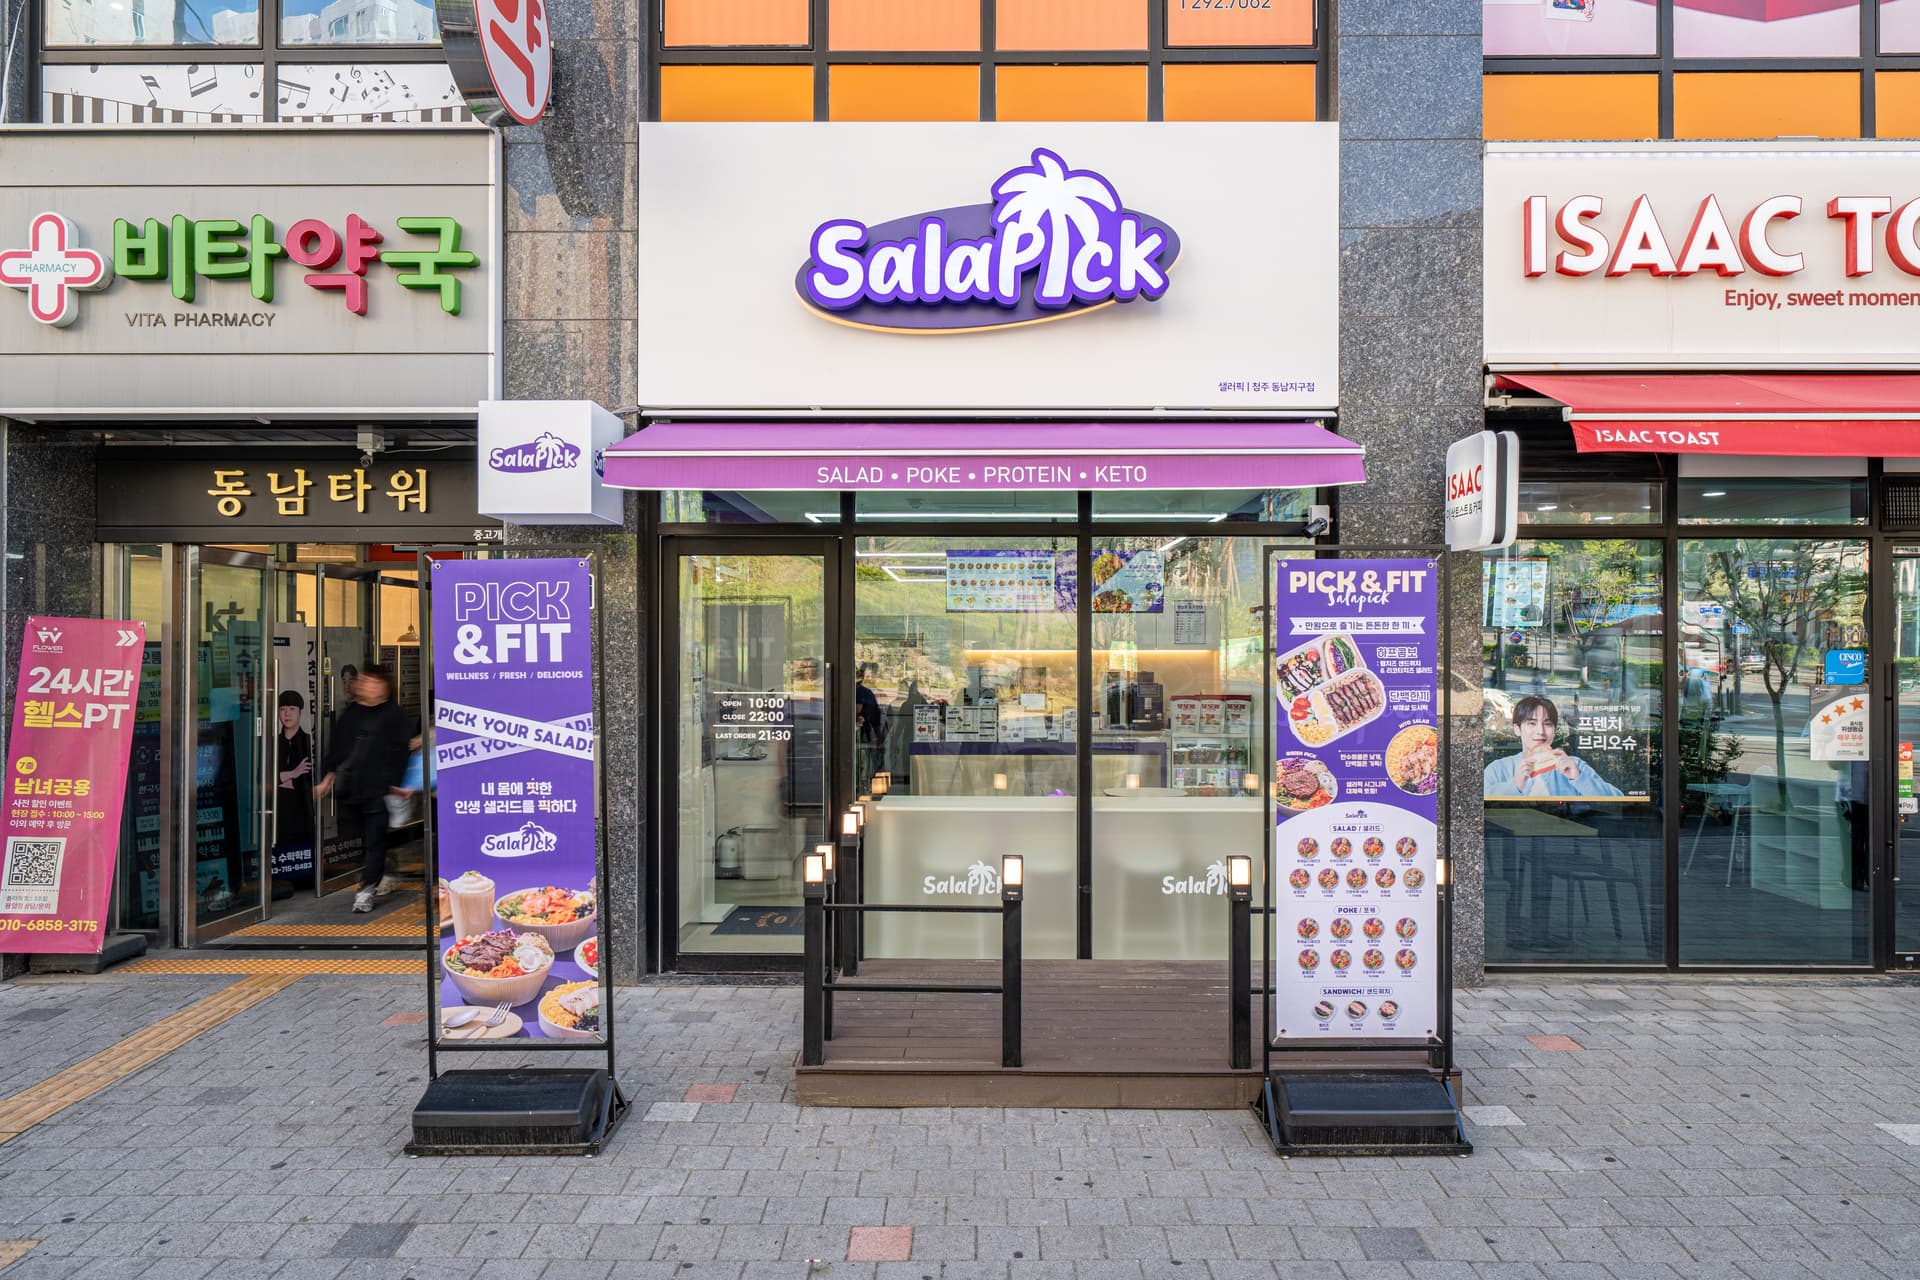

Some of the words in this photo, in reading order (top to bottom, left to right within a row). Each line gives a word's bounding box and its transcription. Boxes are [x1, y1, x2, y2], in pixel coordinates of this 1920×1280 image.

[806, 163, 1168, 306] SalaPick
[1523, 193, 1804, 277] ISAAC
[19, 262, 77, 273] PHARMACY
[113, 213, 480, 316] 비타약국
[1725, 290, 1782, 310] Enjoy,
[1787, 290, 1844, 306] sweet
[125, 312, 166, 327] VITA
[174, 312, 276, 327] PHARMACY
[1271, 381, 1315, 392] 동남지구점
[1594, 429, 1653, 443] ISAAC
[1655, 431, 1719, 446] TOAST
[490, 436, 578, 469] SalaPick
[817, 467, 883, 483] SALAD
[906, 467, 961, 483] POKE
[984, 466, 1071, 482] PROTEIN
[1095, 465, 1147, 482] KETO
[1447, 464, 1482, 502] ISAAC
[207, 468, 427, 516] 동남타워
[1289, 570, 1356, 593] PICK
[455, 581, 571, 622] PICK
[1304, 621, 1337, 631] 만원으로
[1339, 621, 1363, 631] 즐기는
[1365, 621, 1390, 631] 든든한
[453, 623, 571, 664] &FIT
[27, 667, 135, 697] 24시간
[446, 671, 489, 680] WELLNESS
[499, 671, 527, 679] FRESH
[537, 670, 583, 679] DELICIOUS
[749, 698, 785, 709] 10:00
[23, 700, 130, 730] 헬스PT
[749, 711, 784, 722] 22:00
[1578, 716, 1622, 732] 프렌치
[438, 707, 478, 727] PICK
[483, 716, 529, 739] YOUR
[534, 728, 593, 753] SALAD!
[758, 730, 791, 741] 21:30
[1577, 735, 1638, 751] 브리오슈
[438, 743, 478, 763] PICK
[14, 778, 91, 796] 남녀공용
[481, 782, 495, 795] 내
[498, 782, 523, 795] 몸에
[526, 781, 552, 795] 핏한
[12, 800, 30, 808] 사전
[31, 800, 47, 808] 할인
[49, 800, 72, 808] 이벤트
[455, 800, 480, 814] 인생
[483, 800, 535, 814] 샐러드를
[538, 799, 577, 813] 픽하다
[52, 810, 75, 819] 10:00
[83, 811, 105, 819] 15:00
[485, 828, 555, 851] SalaPick
[0, 919, 98, 933] 010-6858-3175
